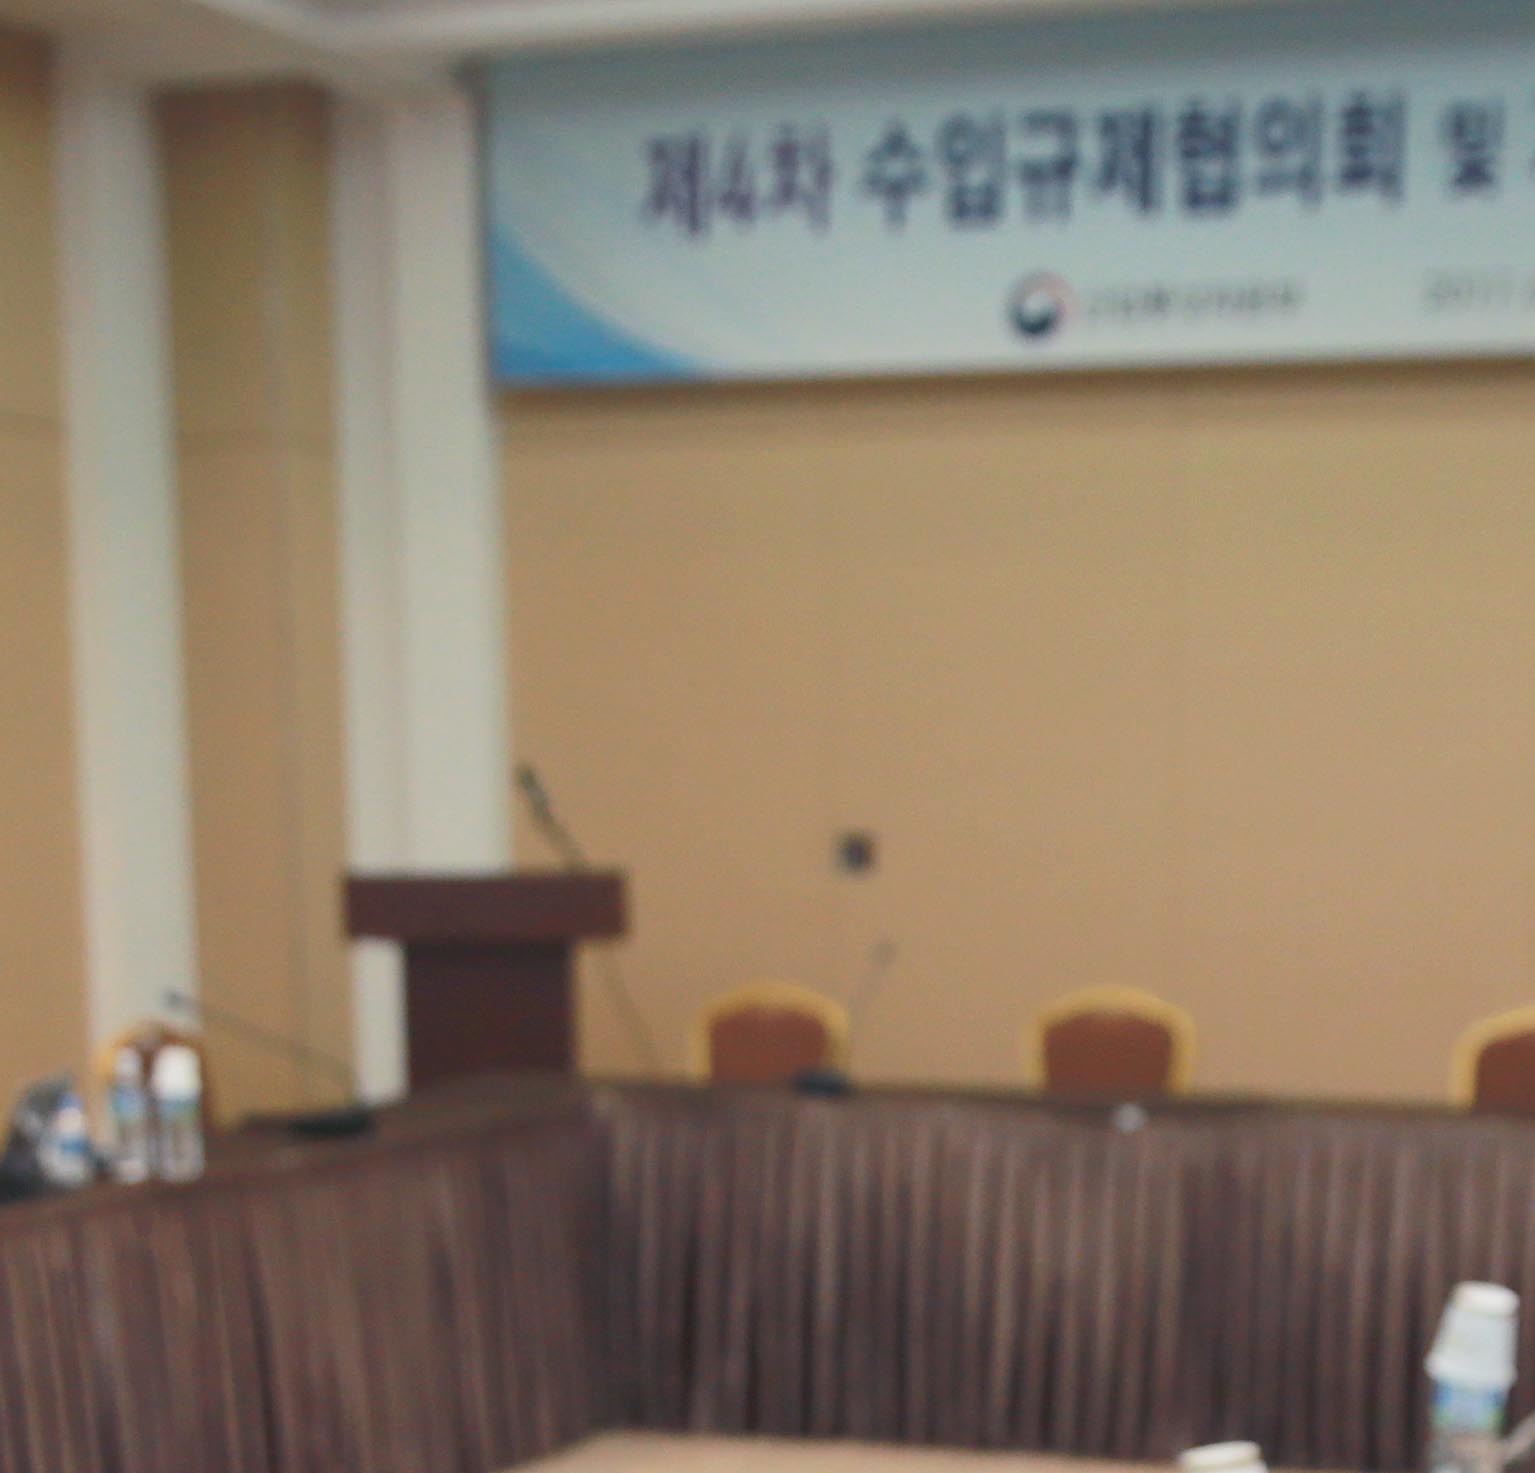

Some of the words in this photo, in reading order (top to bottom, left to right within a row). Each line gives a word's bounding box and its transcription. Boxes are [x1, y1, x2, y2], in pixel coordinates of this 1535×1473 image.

[645, 124, 836, 240] 제4차
[864, 90, 1410, 236] 수입규제협의회
[1441, 96, 1504, 194] 및
